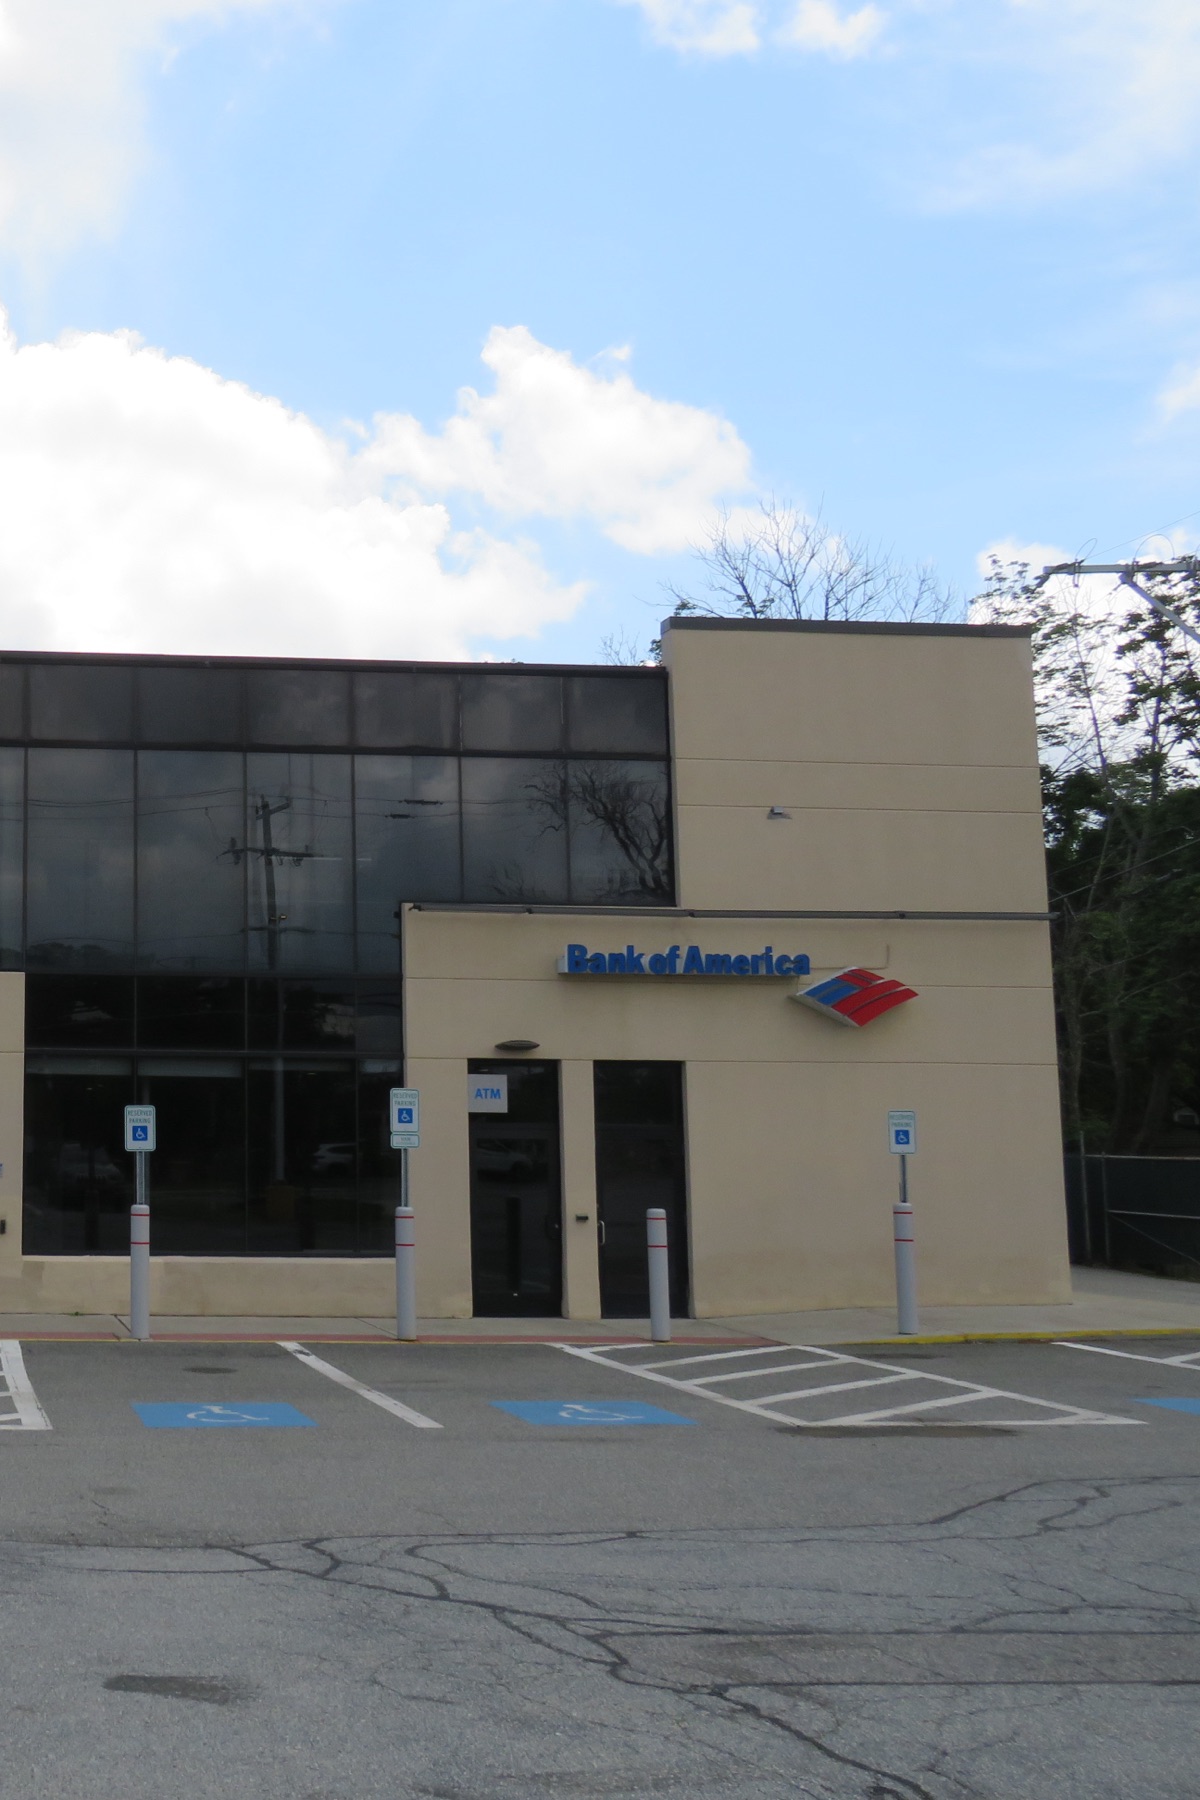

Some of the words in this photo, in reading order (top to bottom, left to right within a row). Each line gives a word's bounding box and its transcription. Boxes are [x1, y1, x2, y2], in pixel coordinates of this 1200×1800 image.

[566, 943, 644, 974] Bank
[648, 945, 679, 975] of
[682, 945, 810, 975] America
[474, 1088, 501, 1099] ATM
